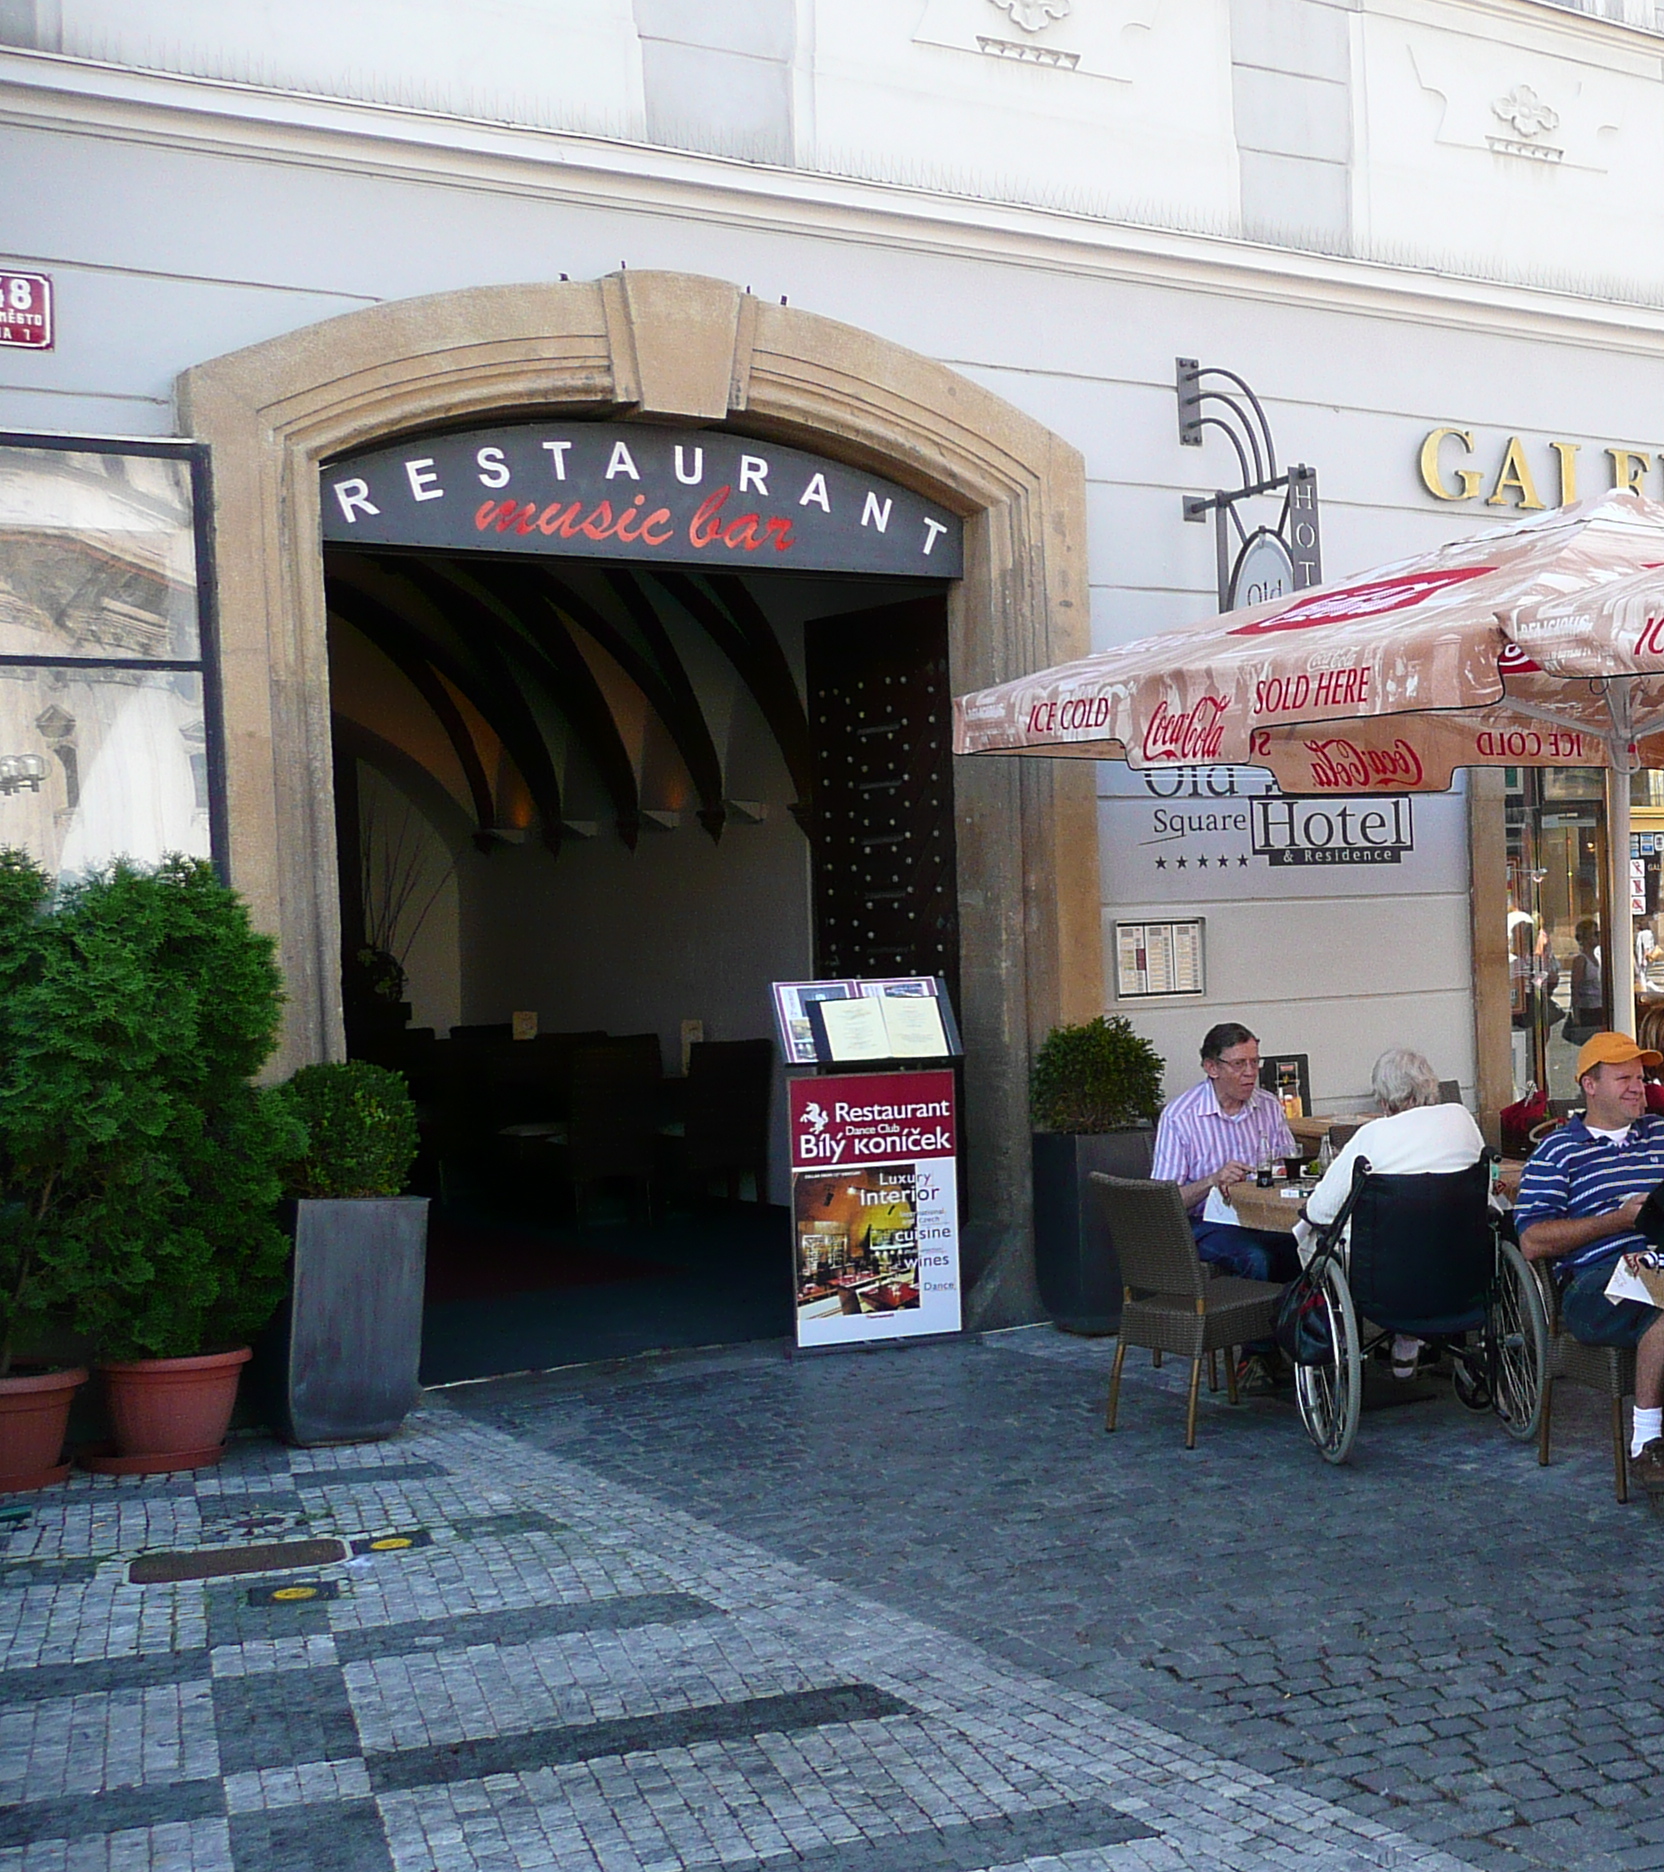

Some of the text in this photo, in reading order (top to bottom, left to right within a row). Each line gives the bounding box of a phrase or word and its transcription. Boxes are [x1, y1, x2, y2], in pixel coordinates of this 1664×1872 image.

[23, 328, 31, 341] 1
[333, 440, 949, 556] RESTAURANT
[473, 484, 797, 552] music bar
[1247, 579, 1282, 606] Old
[1253, 666, 1369, 714] SOLD HERE
[1027, 702, 1057, 733] ICE
[1060, 697, 1109, 730] COLD
[1143, 694, 1231, 761] Coca-Cola
[1153, 809, 1248, 837] Square
[1260, 799, 1408, 848] Hotel
[1283, 848, 1392, 863] & Residence
[834, 1099, 951, 1123] Restaurant
[845, 1123, 900, 1137] Dance Club
[800, 1126, 952, 1163] Bílý koníček
[879, 1173, 932, 1187] Luxury
[860, 1185, 940, 1207] interior
[894, 1226, 951, 1243] cuisine
[904, 1254, 950, 1269] wines
[923, 1280, 955, 1291] Dance
